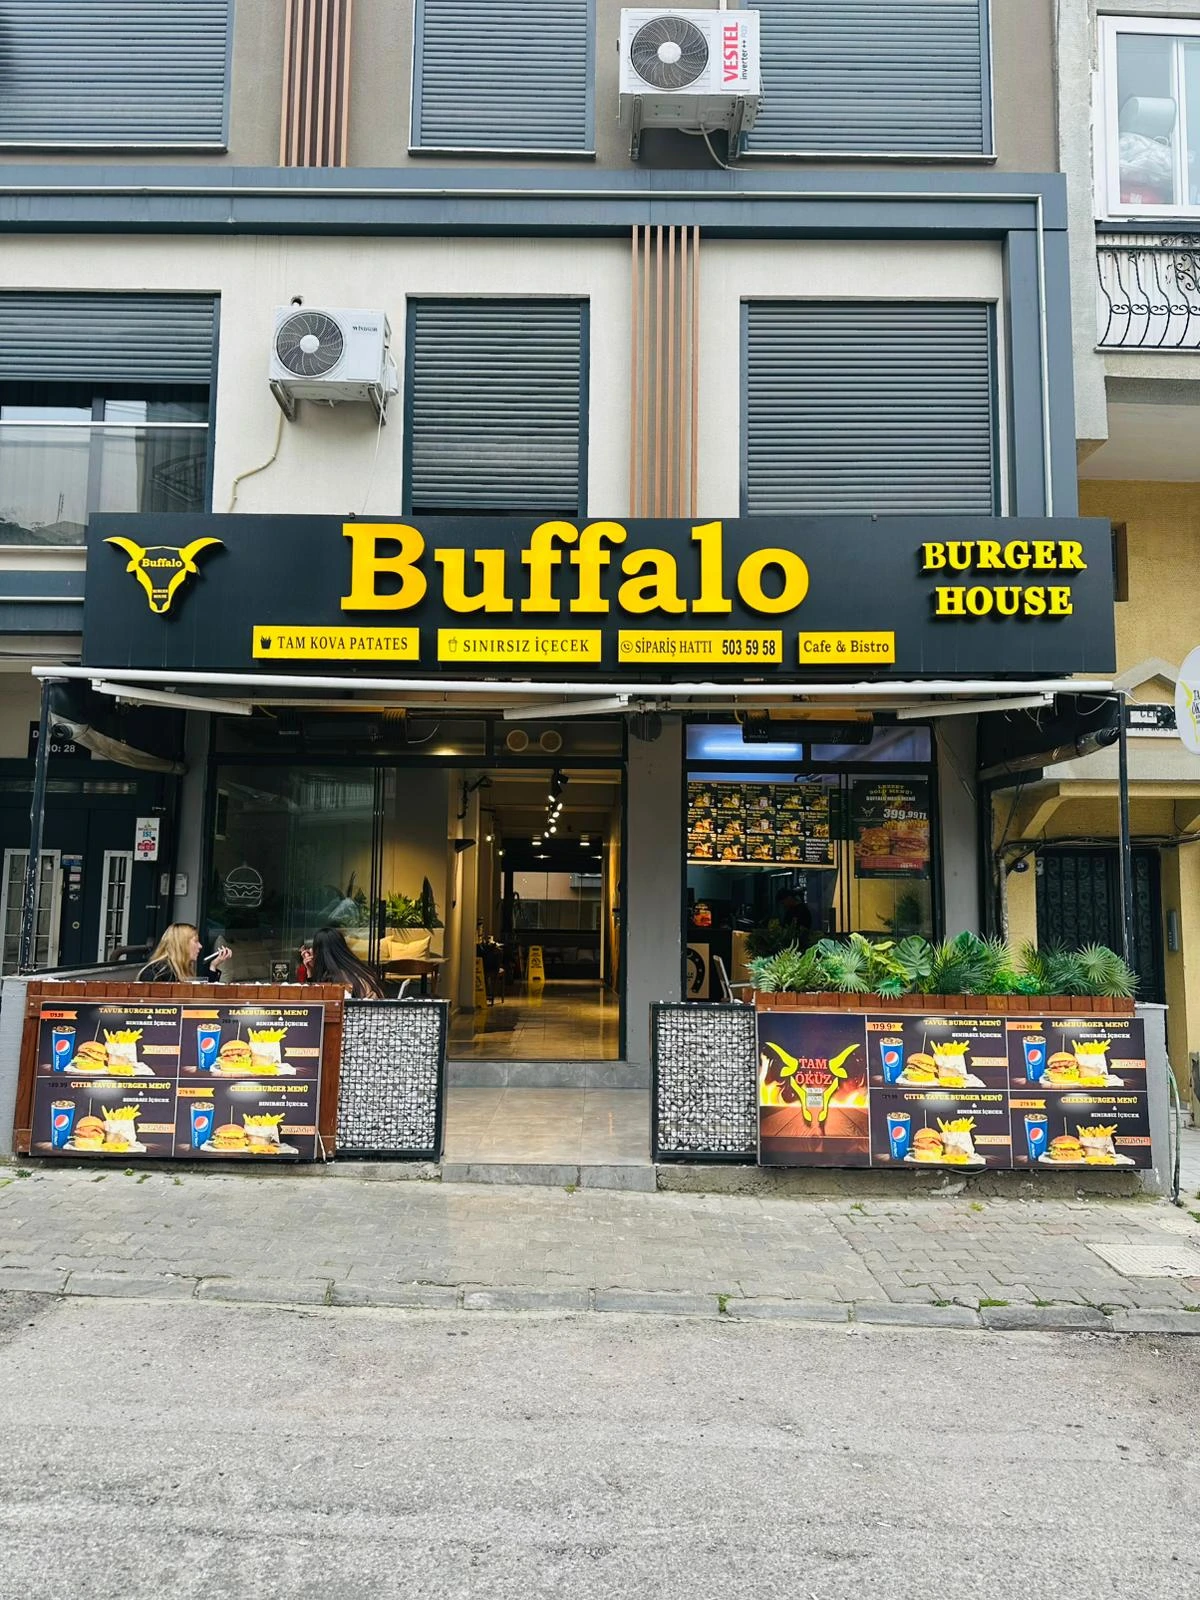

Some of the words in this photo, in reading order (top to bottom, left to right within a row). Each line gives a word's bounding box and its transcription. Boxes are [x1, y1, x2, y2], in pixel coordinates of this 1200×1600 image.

[724, 22, 739, 82] VESTEL
[142, 558, 182, 568] Buffalo
[922, 540, 1087, 570] BURGER
[341, 521, 810, 614] Buffalo
[936, 586, 1072, 615] HOUSE
[278, 636, 306, 650] TAM
[310, 636, 346, 650] KOVA
[350, 636, 408, 650] PATATES
[463, 639, 530, 652] SINIRSIZ
[534, 636, 590, 656] İÇECEK
[635, 636, 676, 658] SİPARİŞ
[680, 640, 712, 654] HATTI
[722, 640, 742, 656] 503
[746, 640, 759, 656] 59
[762, 640, 776, 656] 58
[804, 640, 831, 652] Cafe
[836, 640, 846, 652] &
[850, 640, 890, 653] Bistro
[63, 744, 76, 753] 28
[799, 1058, 828, 1070] TAM
[796, 1070, 832, 1084] ÖKÜZ
